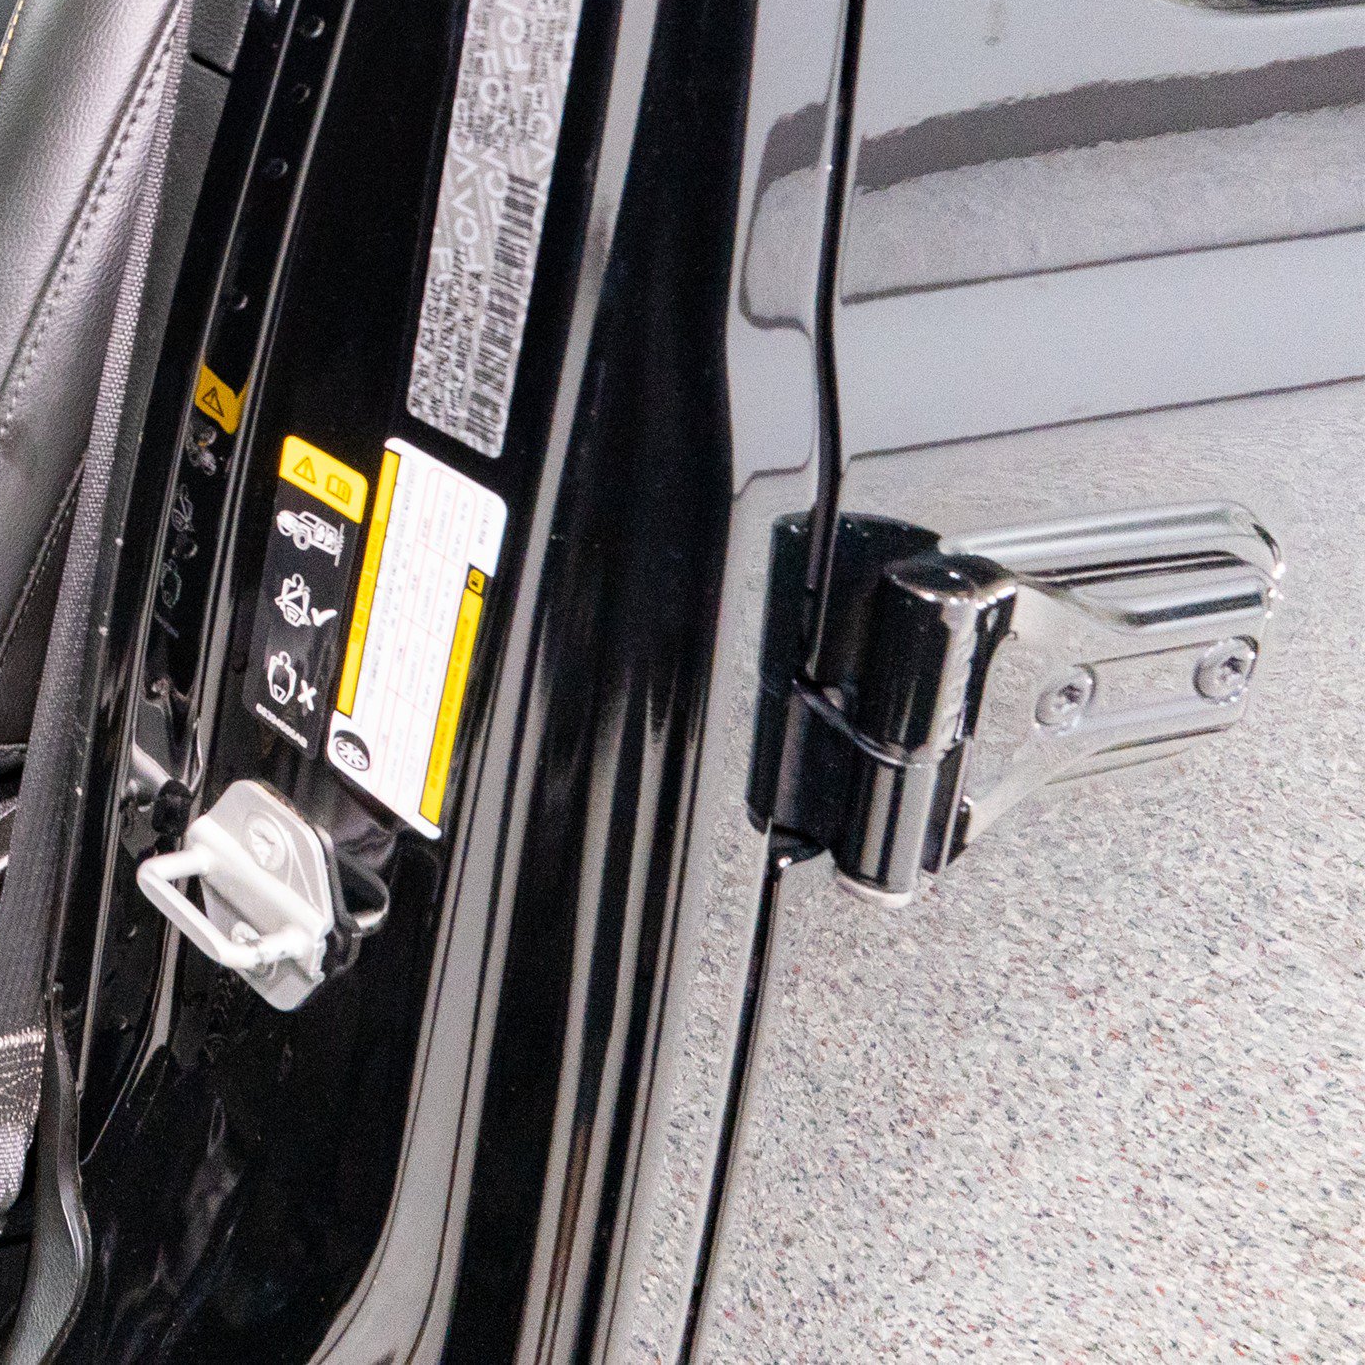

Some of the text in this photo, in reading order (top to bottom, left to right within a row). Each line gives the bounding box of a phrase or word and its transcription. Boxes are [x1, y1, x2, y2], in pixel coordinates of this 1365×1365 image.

[424, 302, 440, 325] US
[460, 313, 475, 332] IN
[419, 323, 437, 354] FCA
[453, 332, 472, 373] MADE
